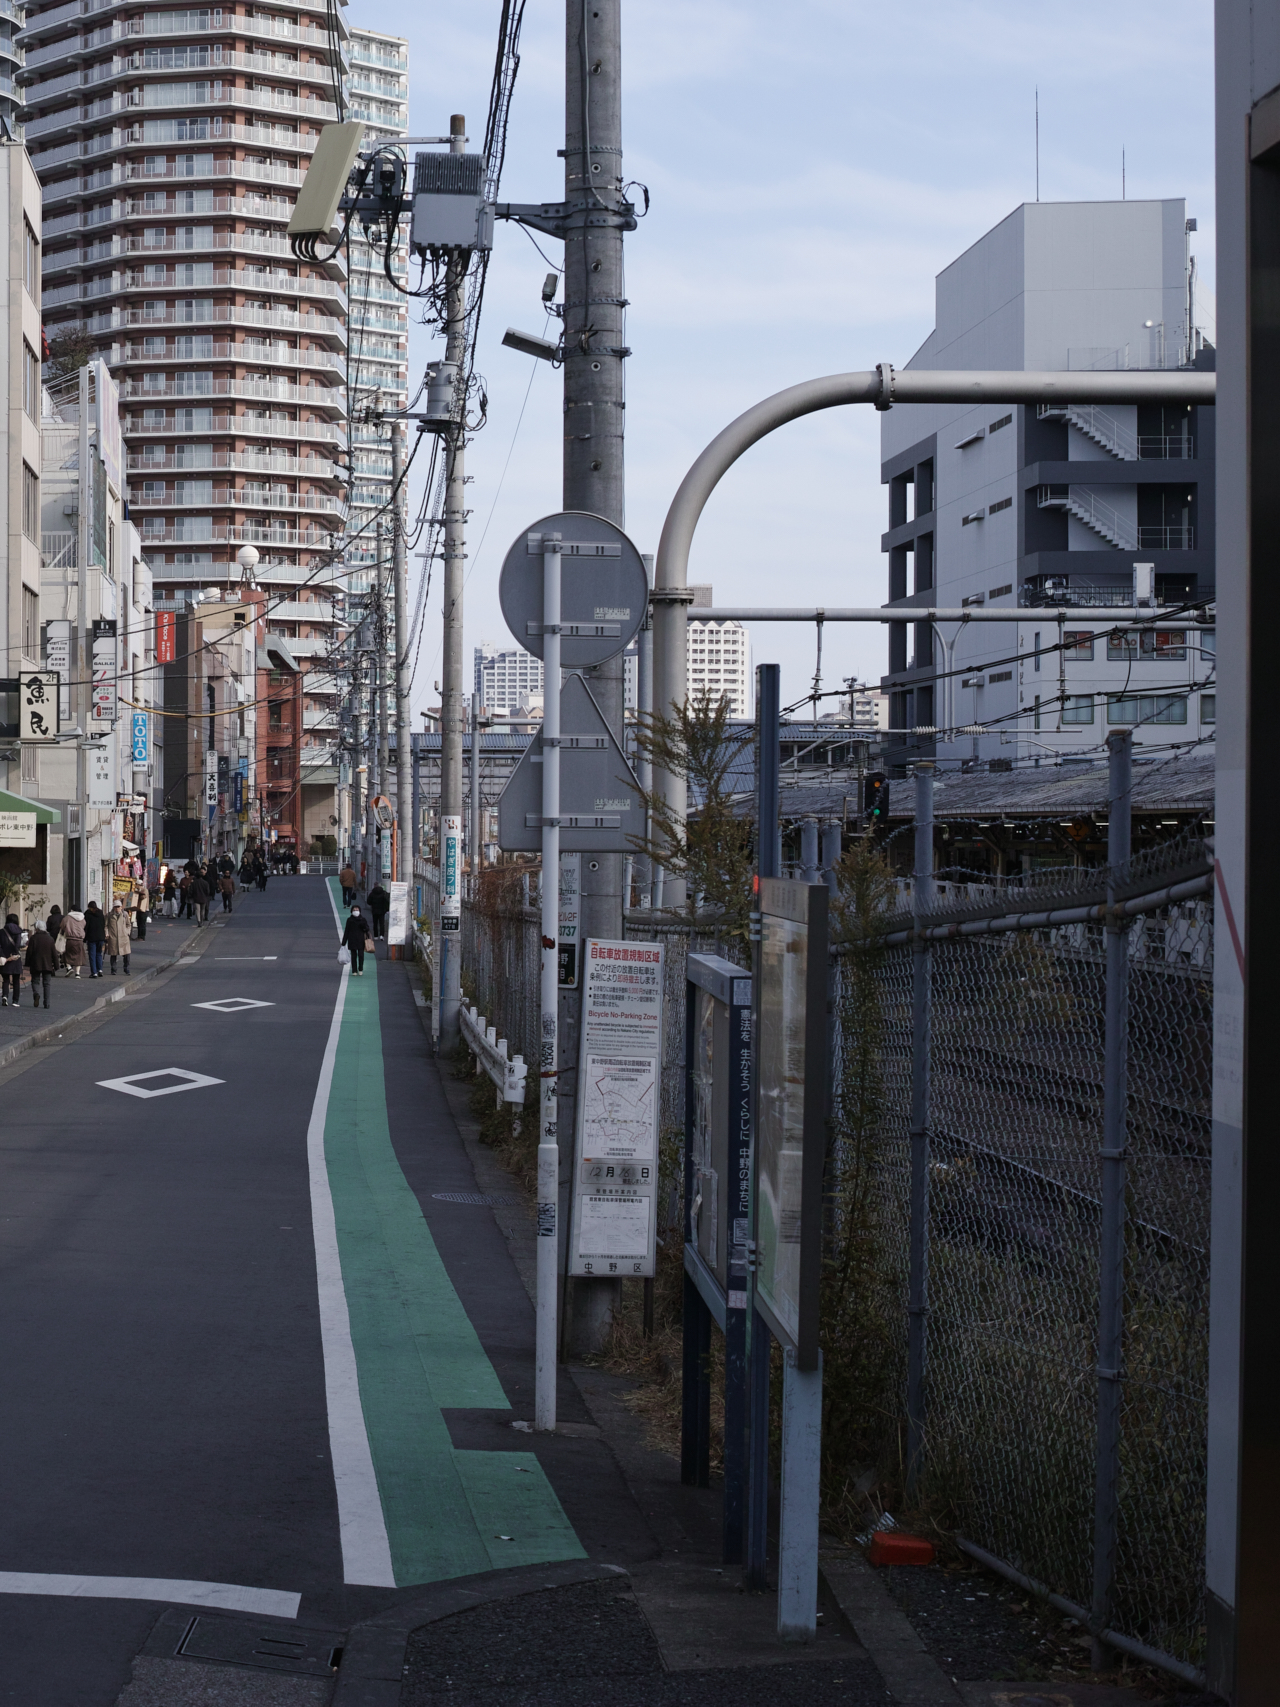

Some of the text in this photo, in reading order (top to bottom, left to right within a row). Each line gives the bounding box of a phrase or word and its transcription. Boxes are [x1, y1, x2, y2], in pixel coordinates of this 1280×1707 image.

[45, 674, 57, 683] 2F
[26, 676, 50, 736] 魚民
[134, 715, 146, 760] TOTO
[446, 838, 455, 894] やはぎ皮フ科
[591, 947, 660, 963] 自転車放置規制区域
[588, 1009, 609, 1019] Bicycle
[610, 1011, 642, 1021] No-Parking
[739, 1008, 751, 1040] 憲法を
[739, 1047, 751, 1093] 生かそう
[739, 1097, 751, 1141] くらしに
[606, 1166, 615, 1177] 月
[641, 1167, 650, 1178] 日
[738, 1147, 751, 1213] 中野のまちに
